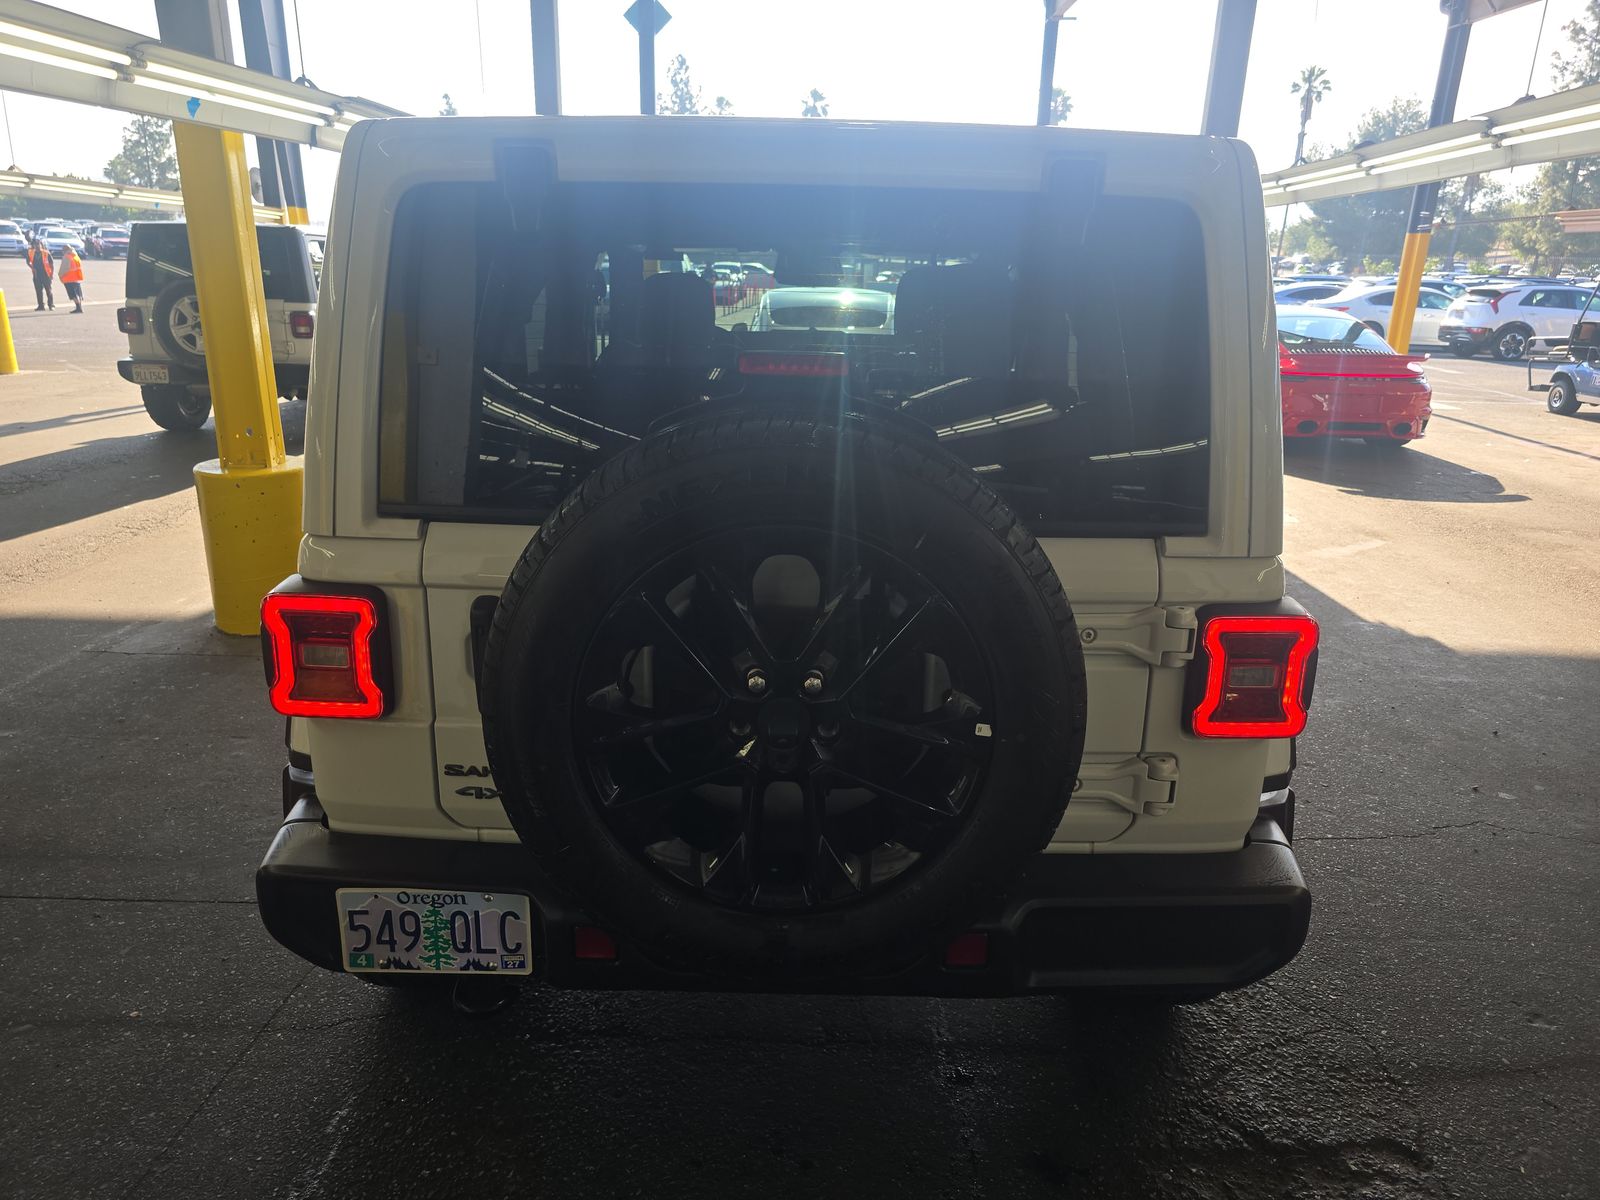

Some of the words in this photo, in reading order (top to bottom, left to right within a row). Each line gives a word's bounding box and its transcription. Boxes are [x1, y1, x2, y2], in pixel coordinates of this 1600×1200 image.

[396, 890, 468, 908] Oregon
[347, 909, 421, 953] 549
[450, 910, 522, 954] QLC
[356, 954, 368, 967] 4
[506, 960, 520, 969] 27
